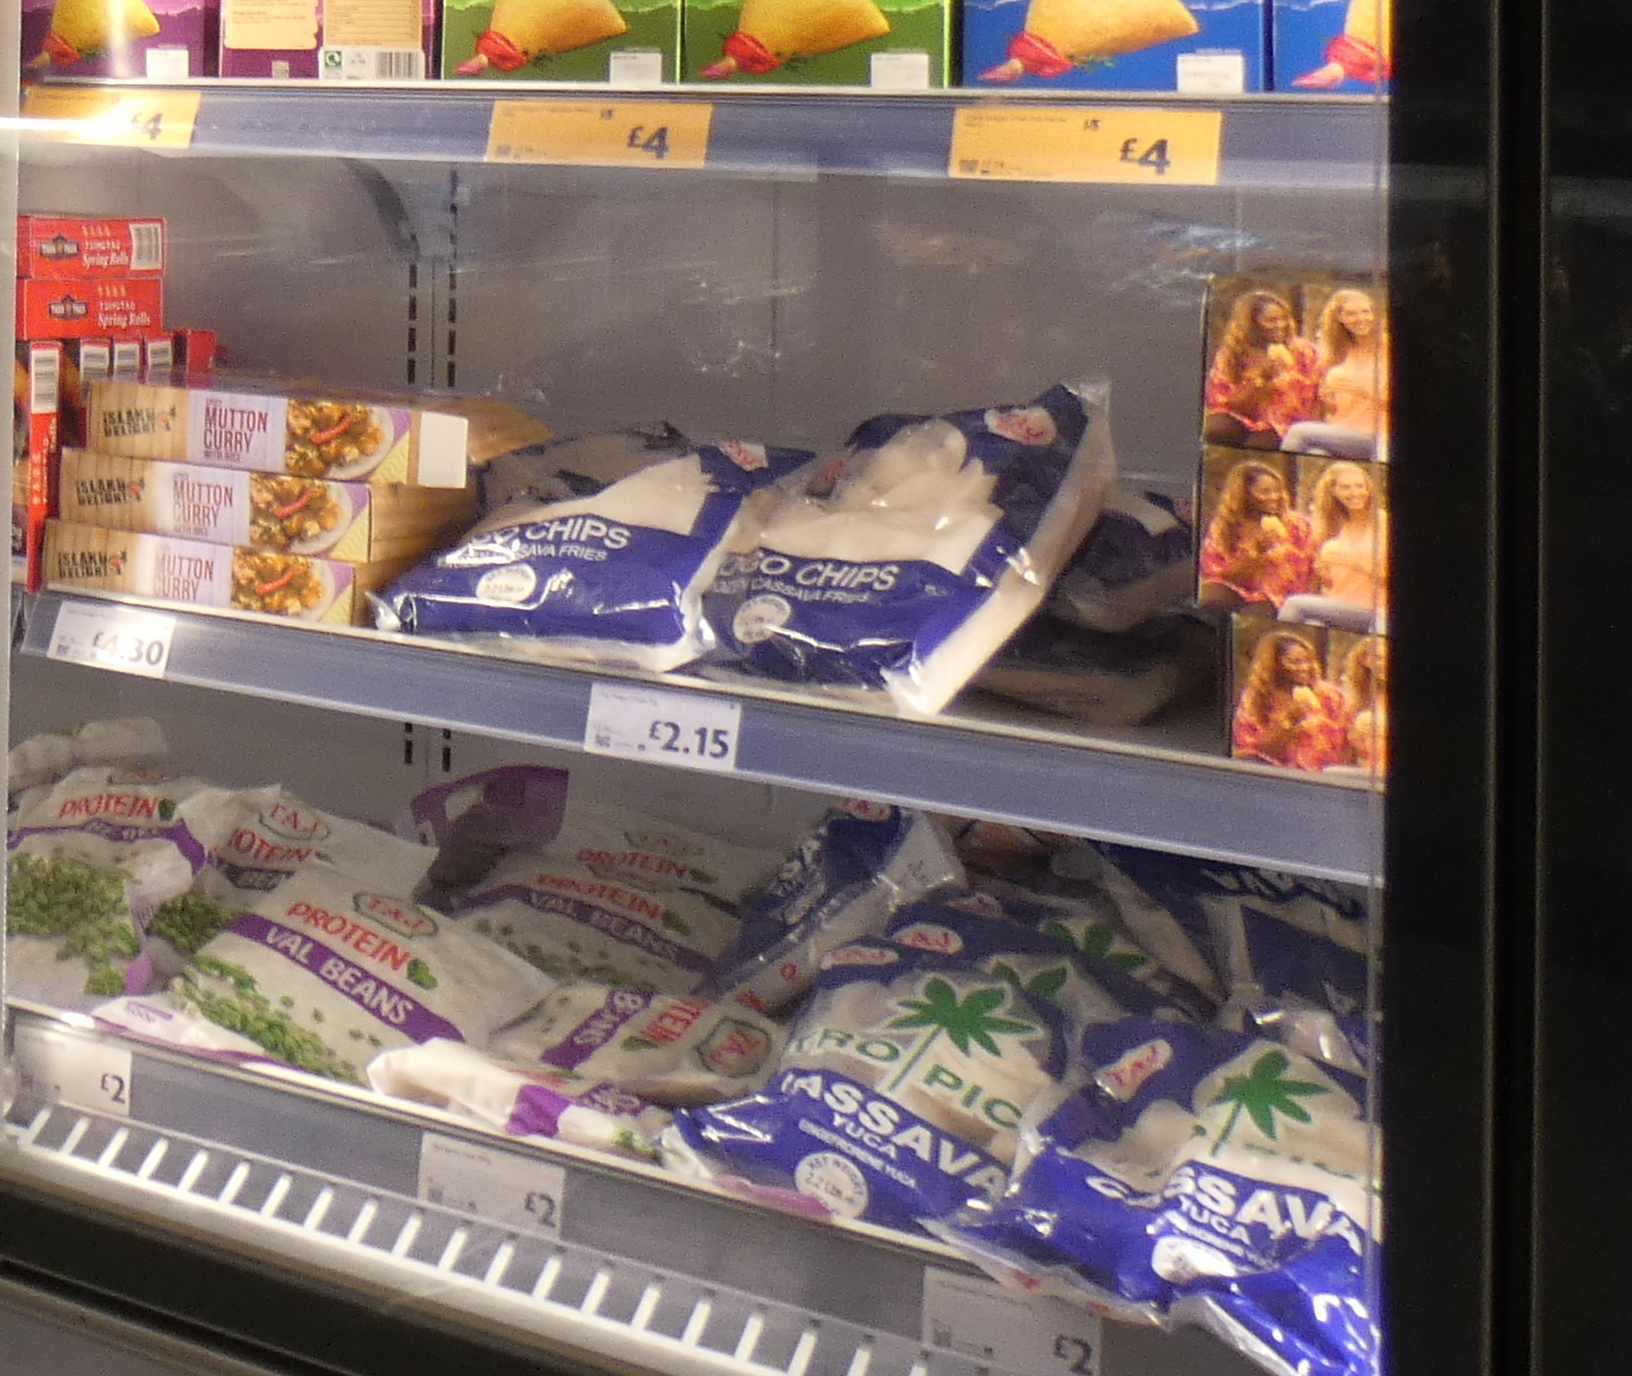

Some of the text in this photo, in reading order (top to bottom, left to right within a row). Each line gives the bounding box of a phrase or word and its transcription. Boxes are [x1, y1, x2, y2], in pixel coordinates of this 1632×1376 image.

[131, 112, 163, 141] £4
[626, 125, 670, 160] £4
[1119, 137, 1171, 175] £4
[205, 406, 269, 433] MUTTON
[203, 428, 254, 454] CURRY
[173, 479, 234, 508] MUTTON
[172, 502, 221, 528] CURRY
[525, 516, 632, 550] CHIPS
[156, 553, 215, 582] MUTTON
[558, 546, 609, 562] FRIES
[152, 576, 200, 602] CURRY
[795, 557, 901, 591] CHIPS
[648, 719, 730, 759] £2.15
[60, 792, 159, 819] PROTEIN
[287, 901, 411, 972] PROTEIN
[266, 927, 416, 1024] VAL BEANS
[100, 1073, 126, 1104] £2
[833, 1112, 898, 1160] YUCA
[524, 1191, 556, 1225] £2
[1179, 1194, 1251, 1245] YUCA
